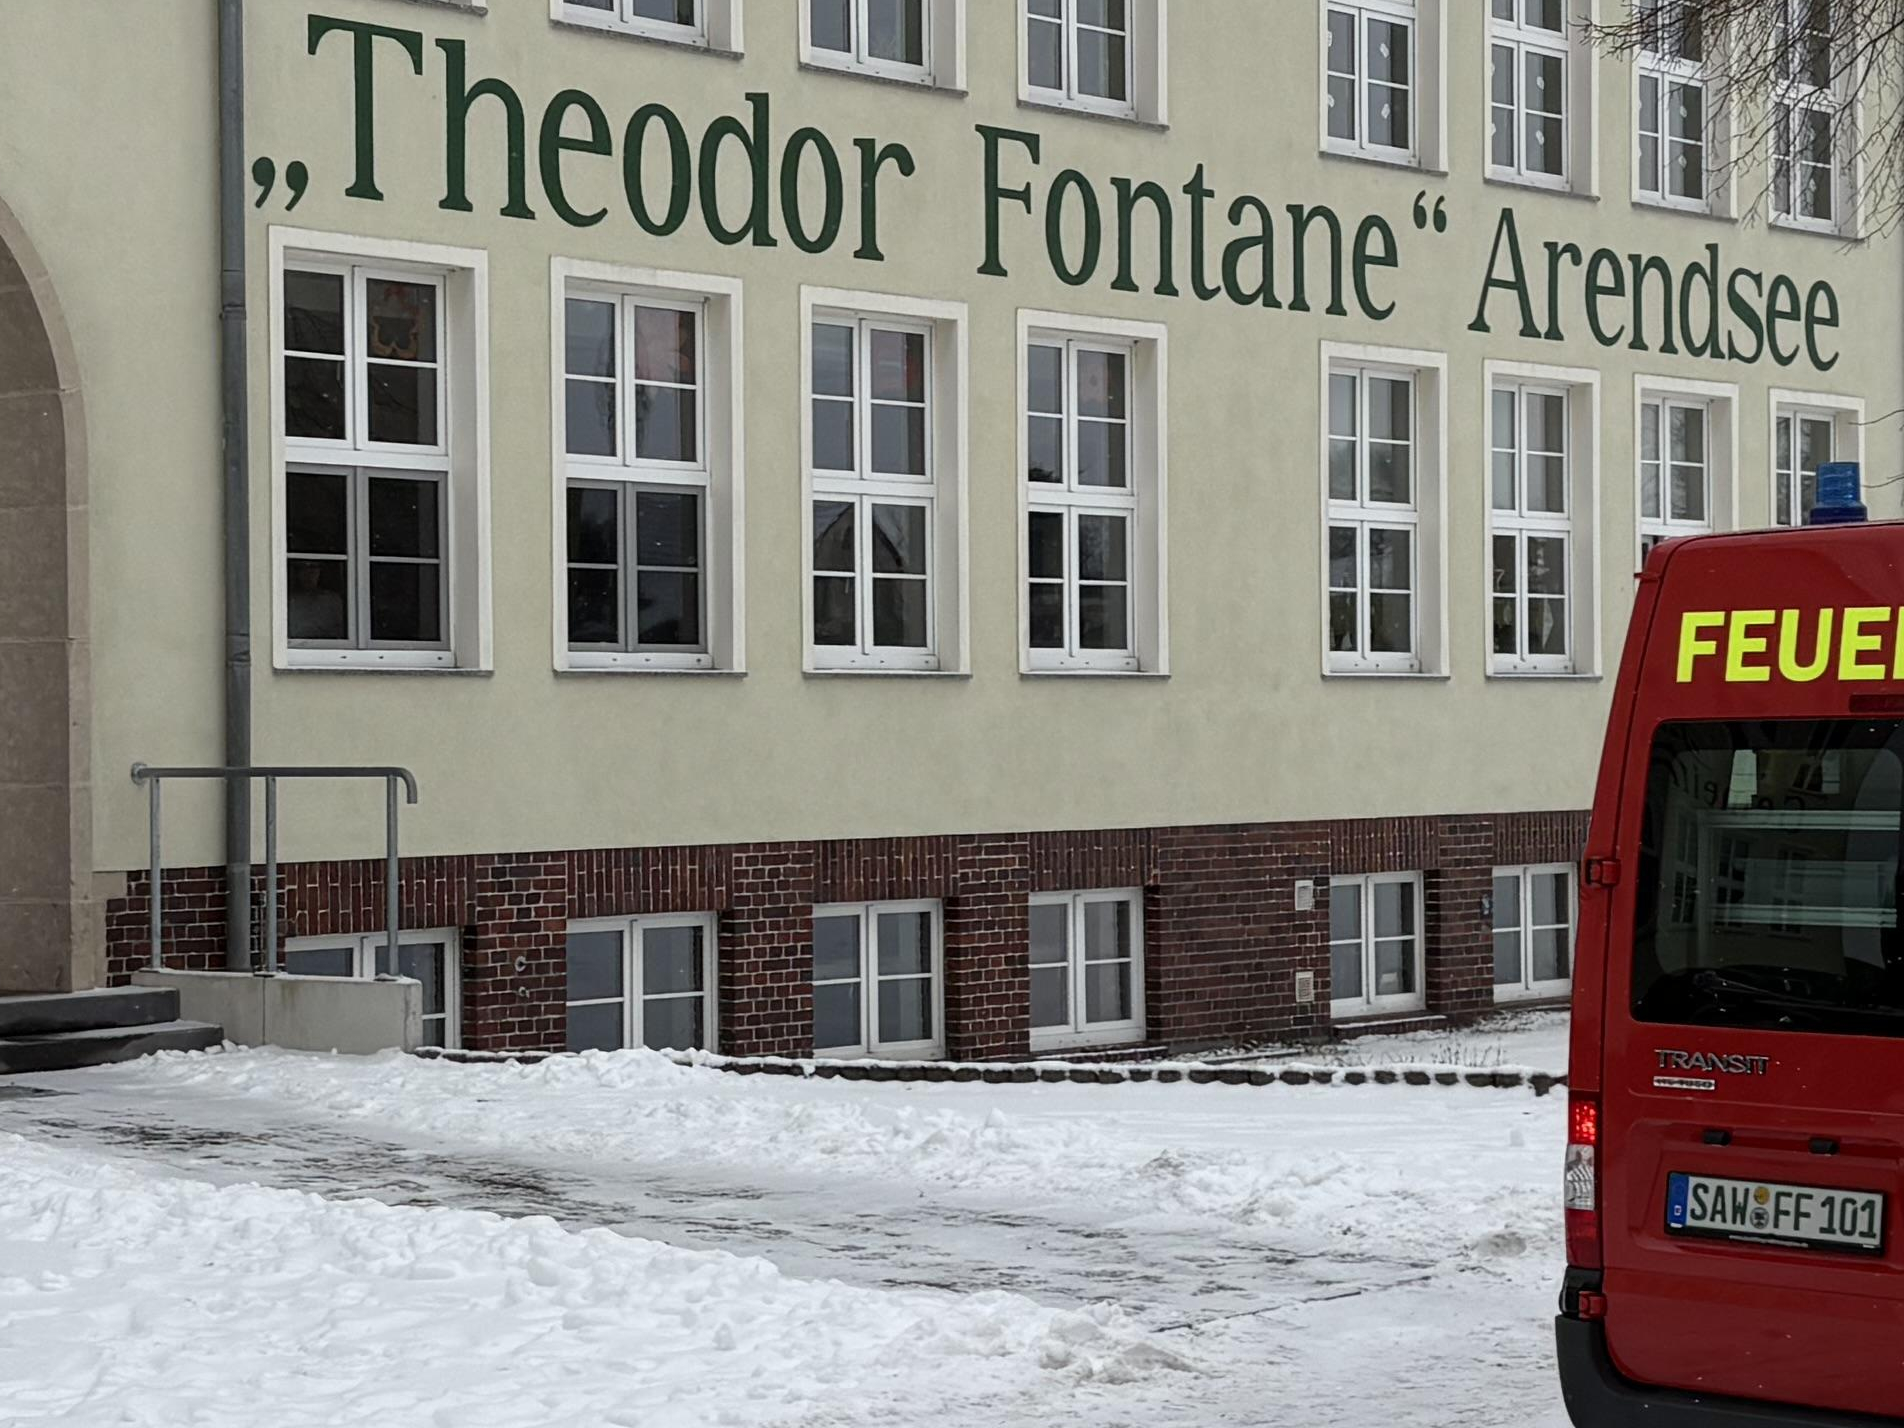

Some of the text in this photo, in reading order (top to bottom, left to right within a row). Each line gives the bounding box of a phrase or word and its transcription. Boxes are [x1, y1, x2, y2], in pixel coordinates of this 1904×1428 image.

[1468, 206, 1840, 372] Arendsee
[1654, 1049, 1769, 1075] TRANSIT
[1689, 1182, 1750, 1225] SAW
